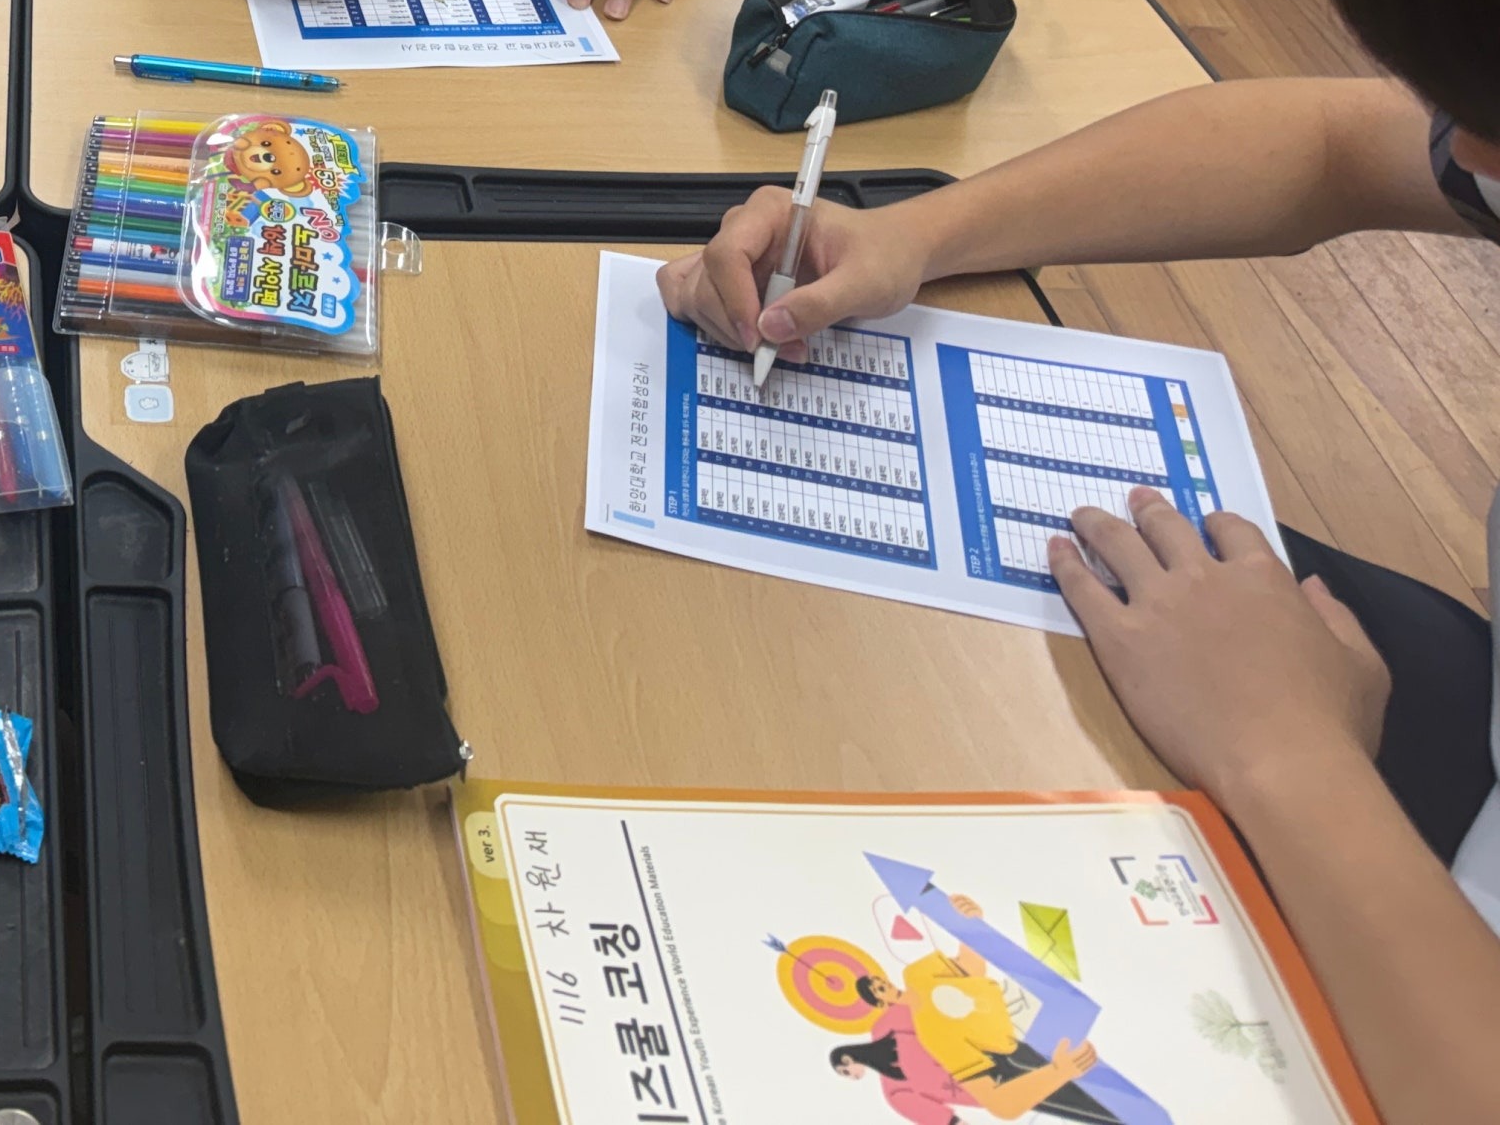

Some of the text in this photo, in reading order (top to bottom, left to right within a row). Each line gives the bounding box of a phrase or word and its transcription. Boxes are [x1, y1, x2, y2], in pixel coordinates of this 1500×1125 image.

[334, 143, 350, 166] NEW
[315, 169, 336, 190] 50
[301, 207, 341, 244] NO
[252, 224, 288, 308] 16색 사인펜
[287, 223, 320, 317] 노마르지
[628, 361, 651, 513] 한양대학교 전공적합성검사
[668, 495, 679, 515] STEP
[971, 556, 983, 575] STEP
[478, 824, 496, 864] ver 3.
[588, 921, 650, 1005] 코칭
[639, 845, 725, 1115] Korean Youth Experience World Education Materials
[545, 969, 587, 1026] 1116
